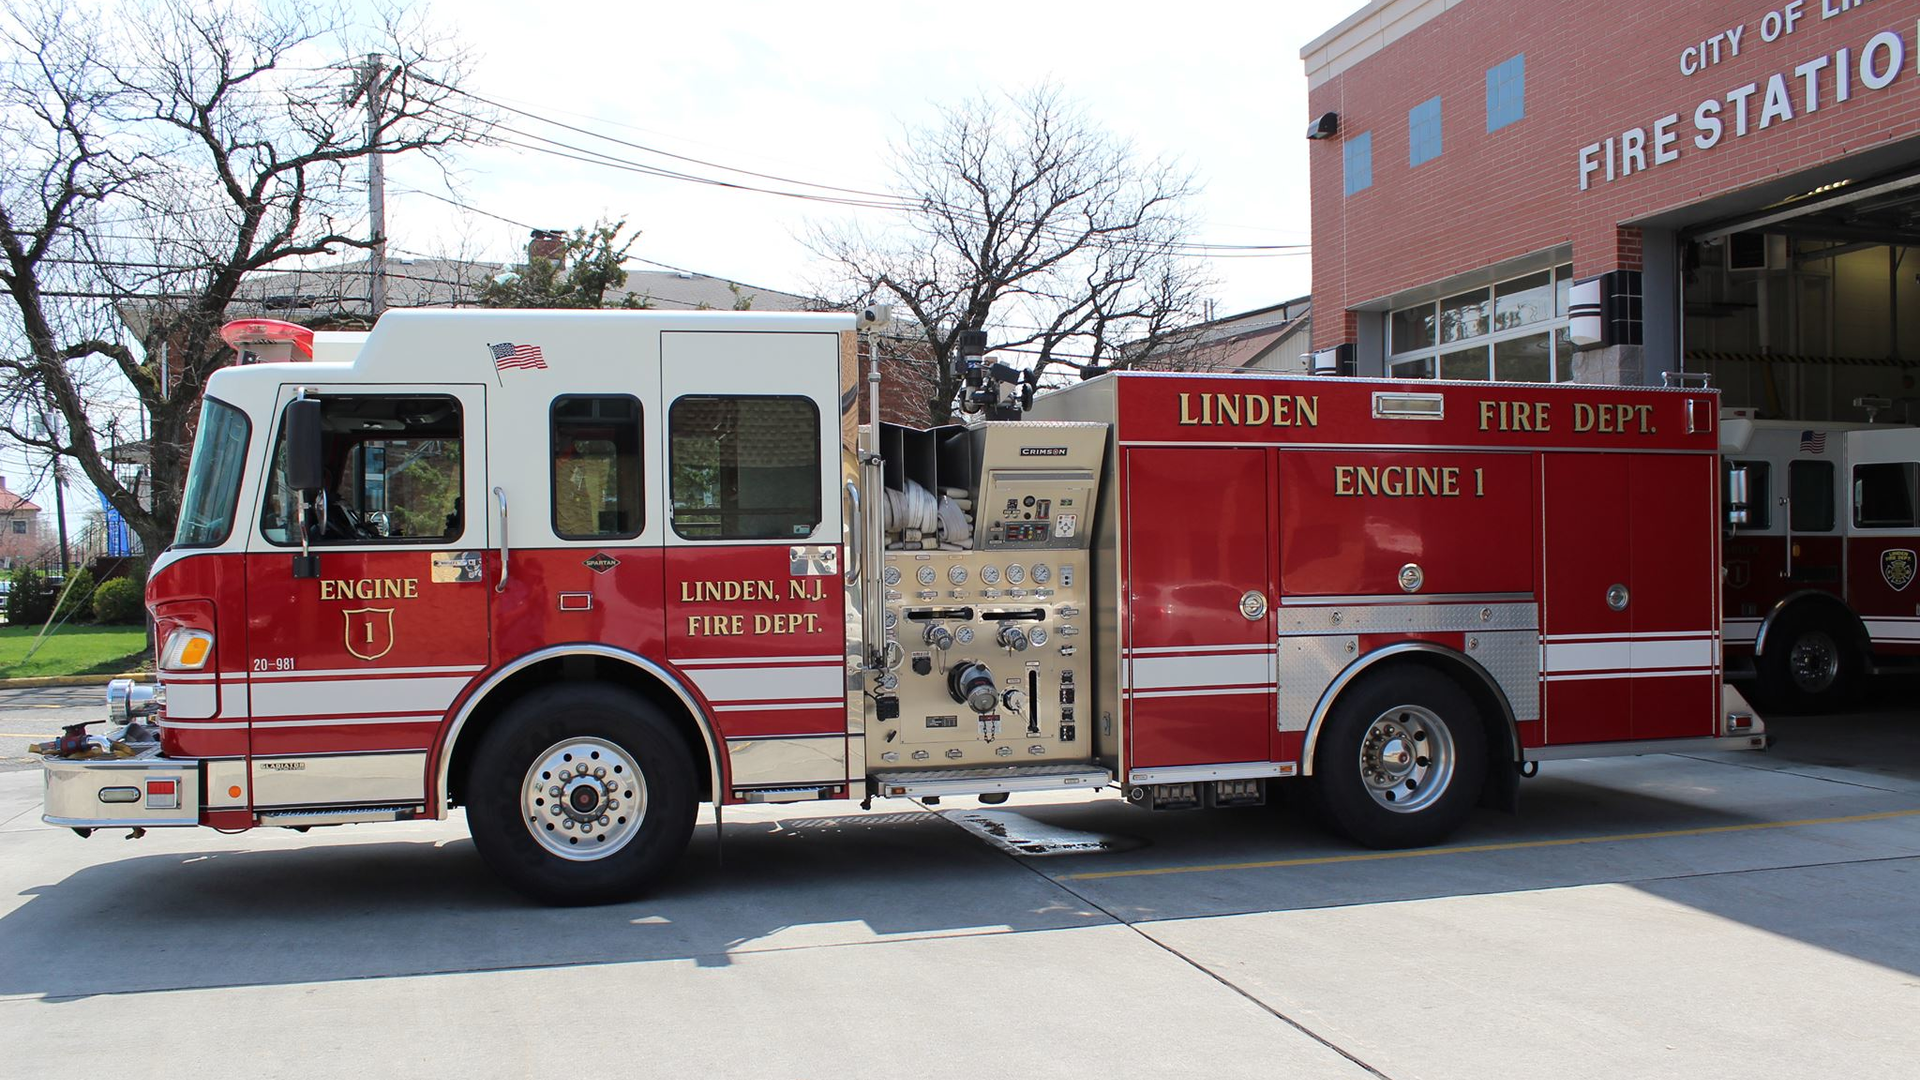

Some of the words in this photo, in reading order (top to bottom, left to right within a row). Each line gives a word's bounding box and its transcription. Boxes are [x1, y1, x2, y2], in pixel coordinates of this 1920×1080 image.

[1680, 25, 1744, 76] CITY
[1760, 0, 1804, 42] OF
[1579, 113, 1679, 191] FIRE
[1694, 18, 1920, 150] STATIO
[1179, 393, 1319, 426] LINDEN
[1479, 401, 1551, 432] FIRE
[1574, 404, 1656, 434] DEPT.
[1335, 466, 1459, 496] ENGINE
[1475, 468, 1485, 496] 1
[320, 578, 419, 600] ENGINE
[681, 579, 780, 602] LINDEN,
[789, 579, 827, 601] N.J.
[365, 621, 374, 643] 1
[688, 614, 744, 636] FIRE
[754, 613, 823, 635] DEPT.
[253, 657, 295, 671] 20-981
